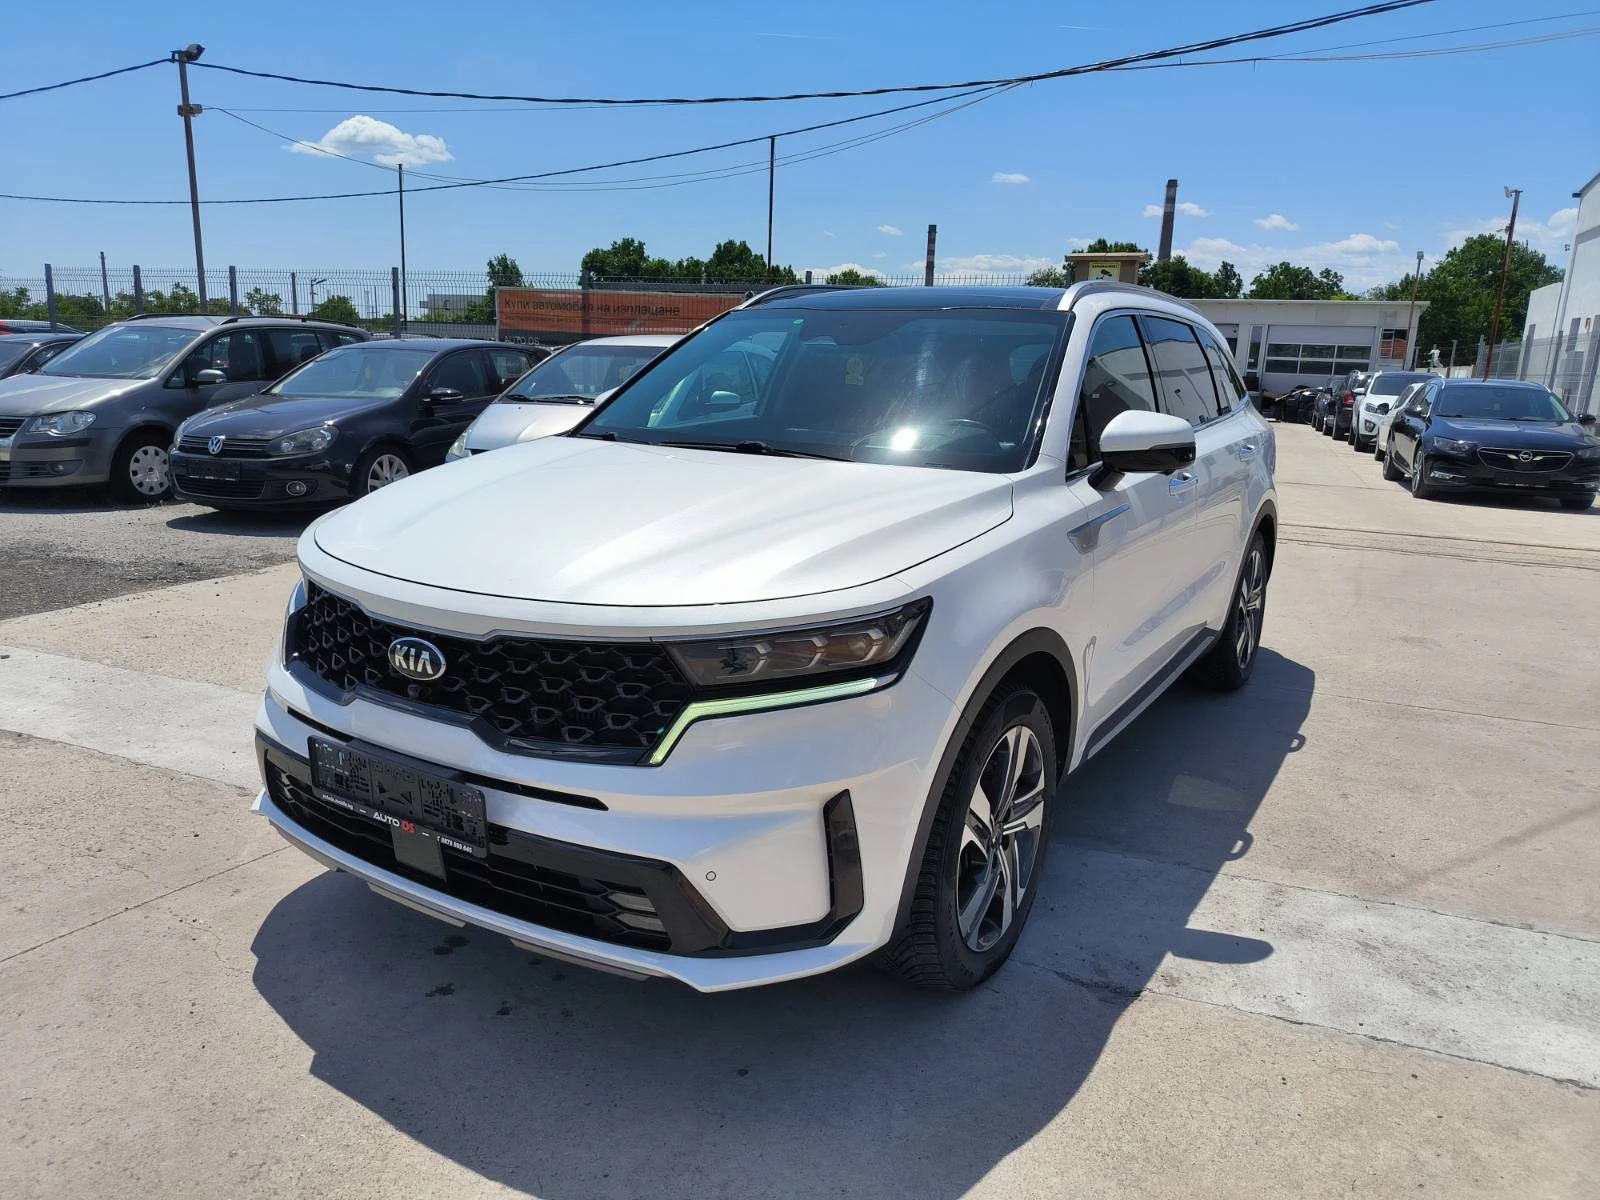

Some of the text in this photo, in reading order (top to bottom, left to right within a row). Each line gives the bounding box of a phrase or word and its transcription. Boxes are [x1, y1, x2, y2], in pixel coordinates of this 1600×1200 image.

[504, 298, 681, 316] Купи автомобил на изплащане
[504, 336, 541, 346] AUTO DS
[395, 644, 434, 675] KIA
[373, 811, 416, 833] AUTO DS
